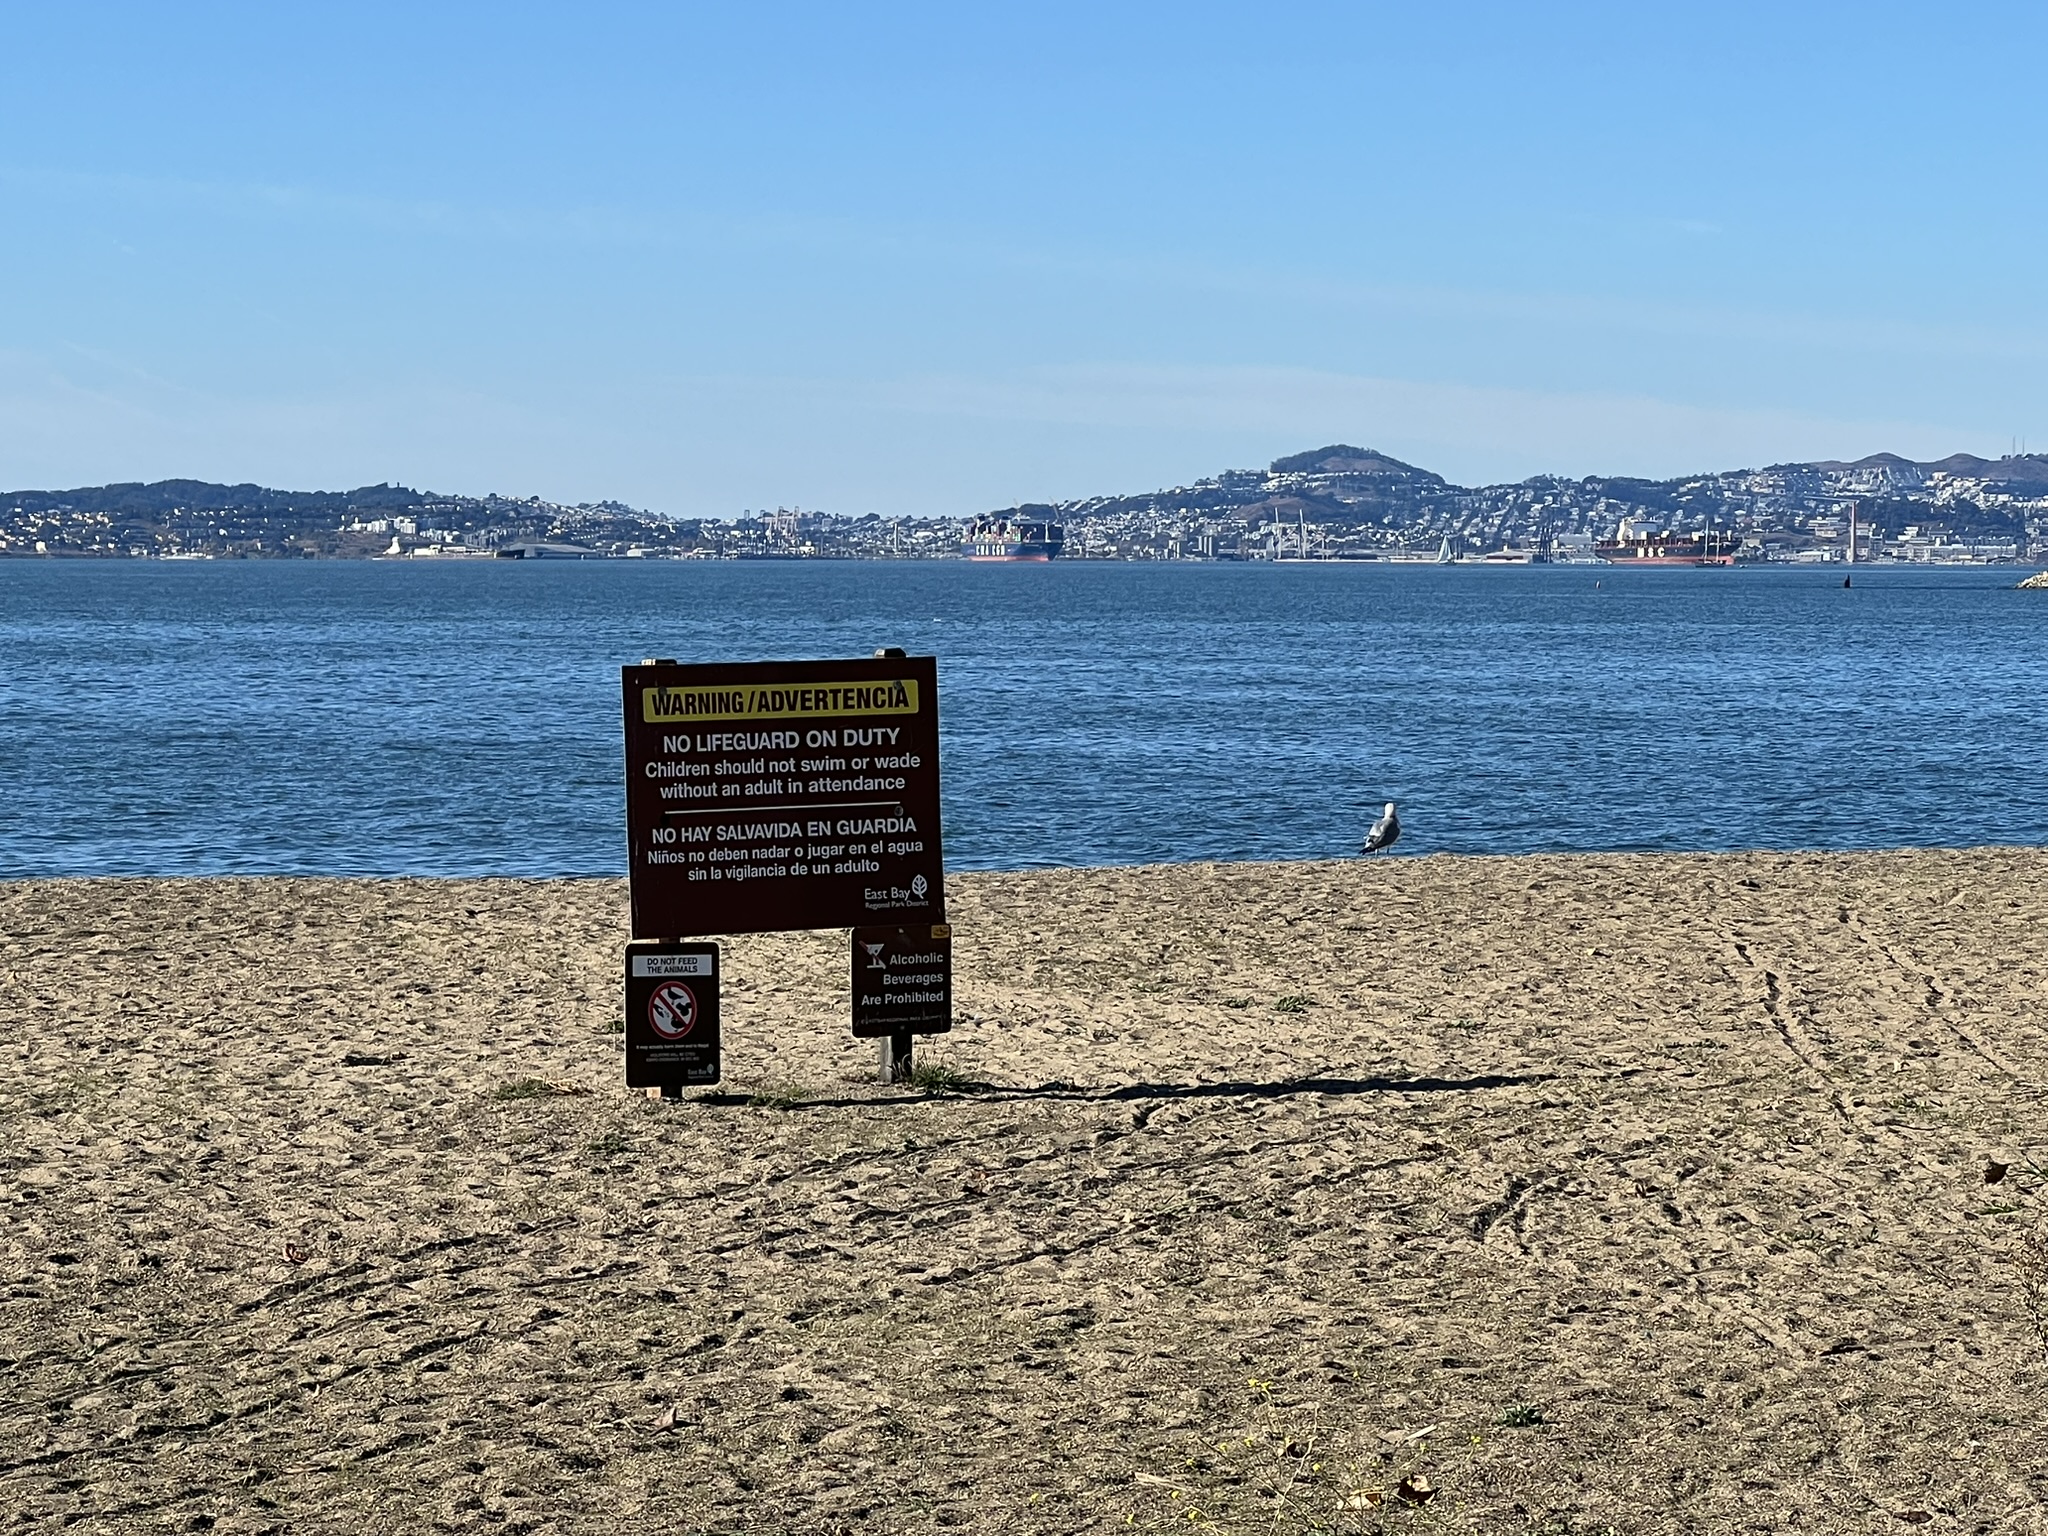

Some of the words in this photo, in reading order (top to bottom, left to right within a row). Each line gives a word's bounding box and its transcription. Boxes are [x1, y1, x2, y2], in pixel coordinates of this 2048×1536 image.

[664, 735, 690, 753] NO
[697, 732, 799, 751] LIFEGUARD
[807, 730, 836, 747] ON
[844, 728, 900, 746] DUTY
[646, 761, 709, 777] Children
[715, 758, 764, 775] should
[770, 758, 795, 772] not
[801, 756, 845, 771] swim
[852, 758, 869, 769] or
[875, 753, 920, 768] wade
[660, 783, 717, 798] without
[722, 785, 739, 796] an
[745, 779, 783, 795] adult
[788, 778, 802, 793] in
[809, 776, 905, 792] attendance
[653, 828, 676, 843] NO
[682, 826, 712, 842] HAY
[717, 823, 802, 840] SALVAVIDA
[808, 821, 831, 836] EN
[837, 818, 916, 835] GUARDIA
[648, 851, 684, 864] Niños
[689, 852, 704, 862] no
[709, 848, 748, 861] deben
[752, 845, 790, 859] nadar
[795, 847, 803, 856] o
[808, 844, 844, 859] jugar
[849, 845, 866, 854] en
[871, 840, 883, 853] el
[888, 842, 922, 855] agua
[689, 868, 706, 880] sin
[711, 867, 721, 879] la
[726, 863, 786, 881] vigilancia
[791, 863, 807, 875] de
[813, 864, 830, 874] un
[835, 860, 879, 873] adulto
[865, 889, 887, 899] East
[891, 887, 911, 901] Bay
[647, 958, 659, 966] DO
[660, 957, 676, 965] NOT
[678, 957, 698, 965] FEED
[890, 953, 943, 964] Alcoholic
[647, 966, 662, 974] THE
[663, 965, 698, 973] ANIMALS
[884, 974, 943, 985] Beverages
[862, 995, 881, 1005] Are
[885, 991, 943, 1004] Prohibited
